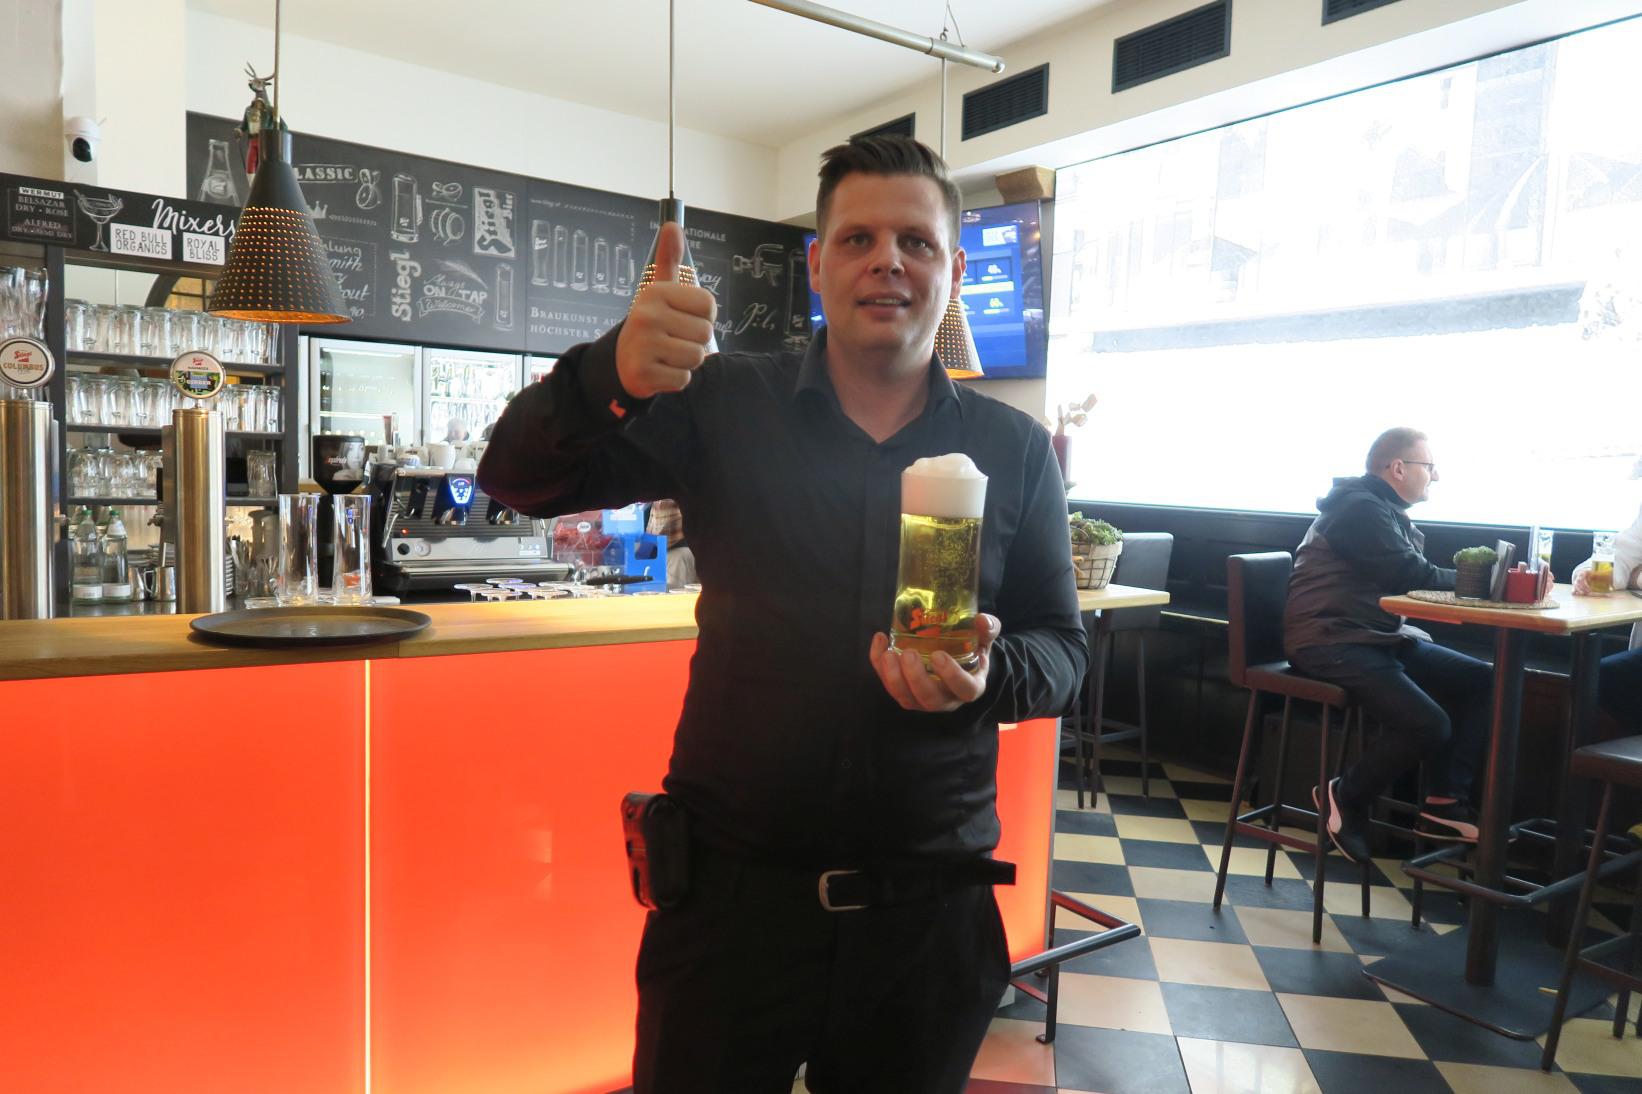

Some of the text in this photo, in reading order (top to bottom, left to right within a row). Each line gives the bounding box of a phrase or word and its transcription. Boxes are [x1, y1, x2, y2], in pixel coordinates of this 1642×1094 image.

[293, 167, 353, 180] LASSIC
[21, 187, 63, 199] WERMUT
[15, 203, 35, 213] DRY
[151, 198, 236, 243] Mixers
[115, 228, 168, 245] RED BULL
[115, 239, 168, 255] ORGANICS
[186, 238, 220, 252] ROYAL
[189, 249, 219, 262] BLISS
[390, 248, 422, 322] Stiegl
[423, 284, 488, 305] ON TAP
[530, 306, 598, 324] BRAUKUNST
[2, 362, 45, 371] COLUMBUS
